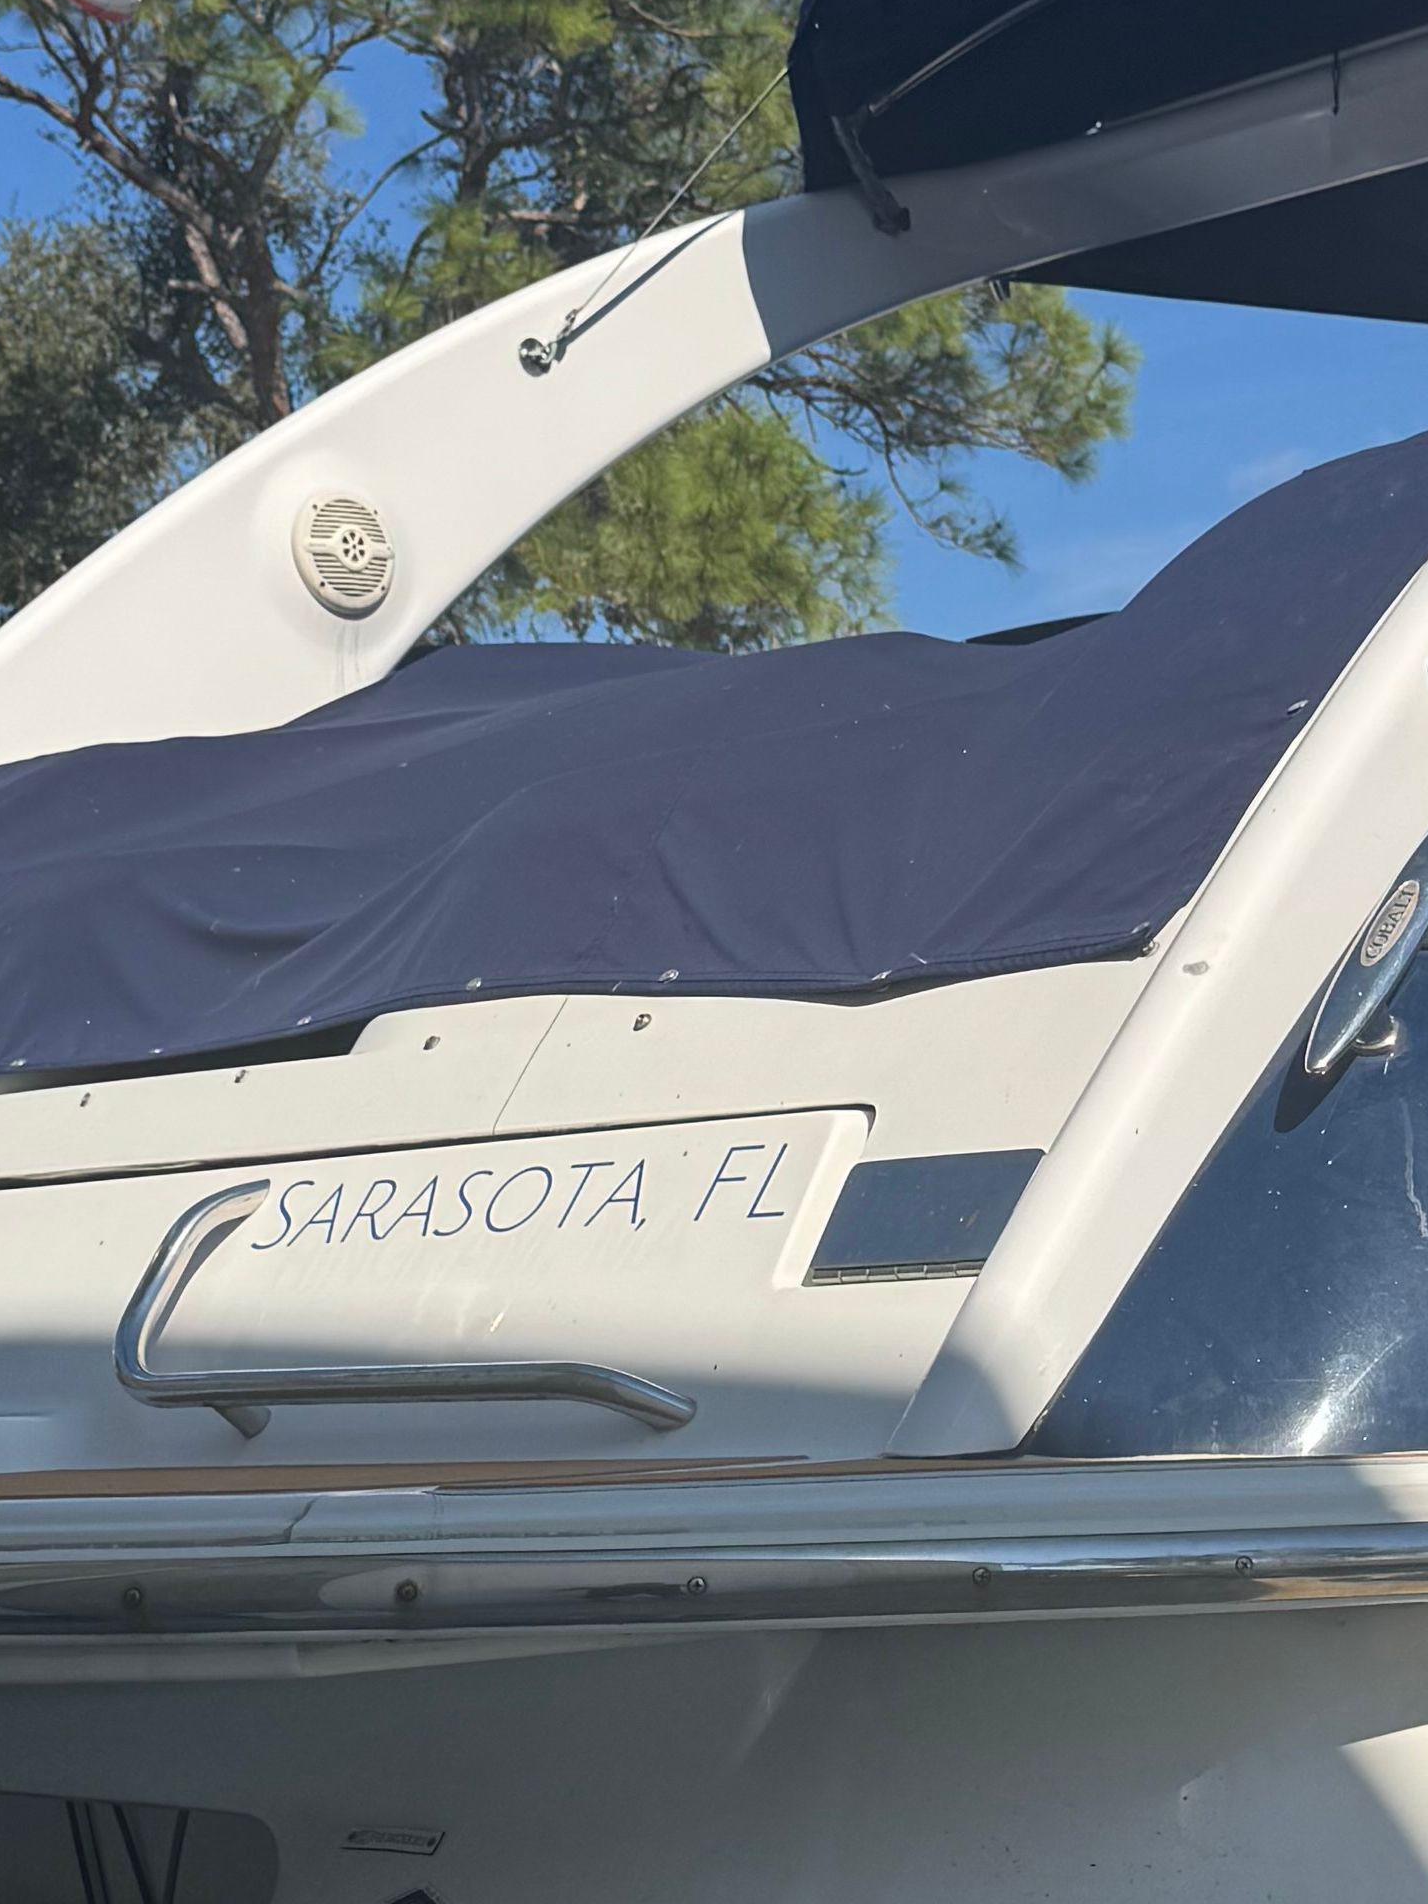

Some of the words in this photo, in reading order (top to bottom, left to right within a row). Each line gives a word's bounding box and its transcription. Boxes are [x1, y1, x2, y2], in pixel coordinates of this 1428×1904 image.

[1365, 887, 1415, 959] COBALT
[251, 1158, 647, 1250] SARASOTA,
[693, 1143, 789, 1222] FL
